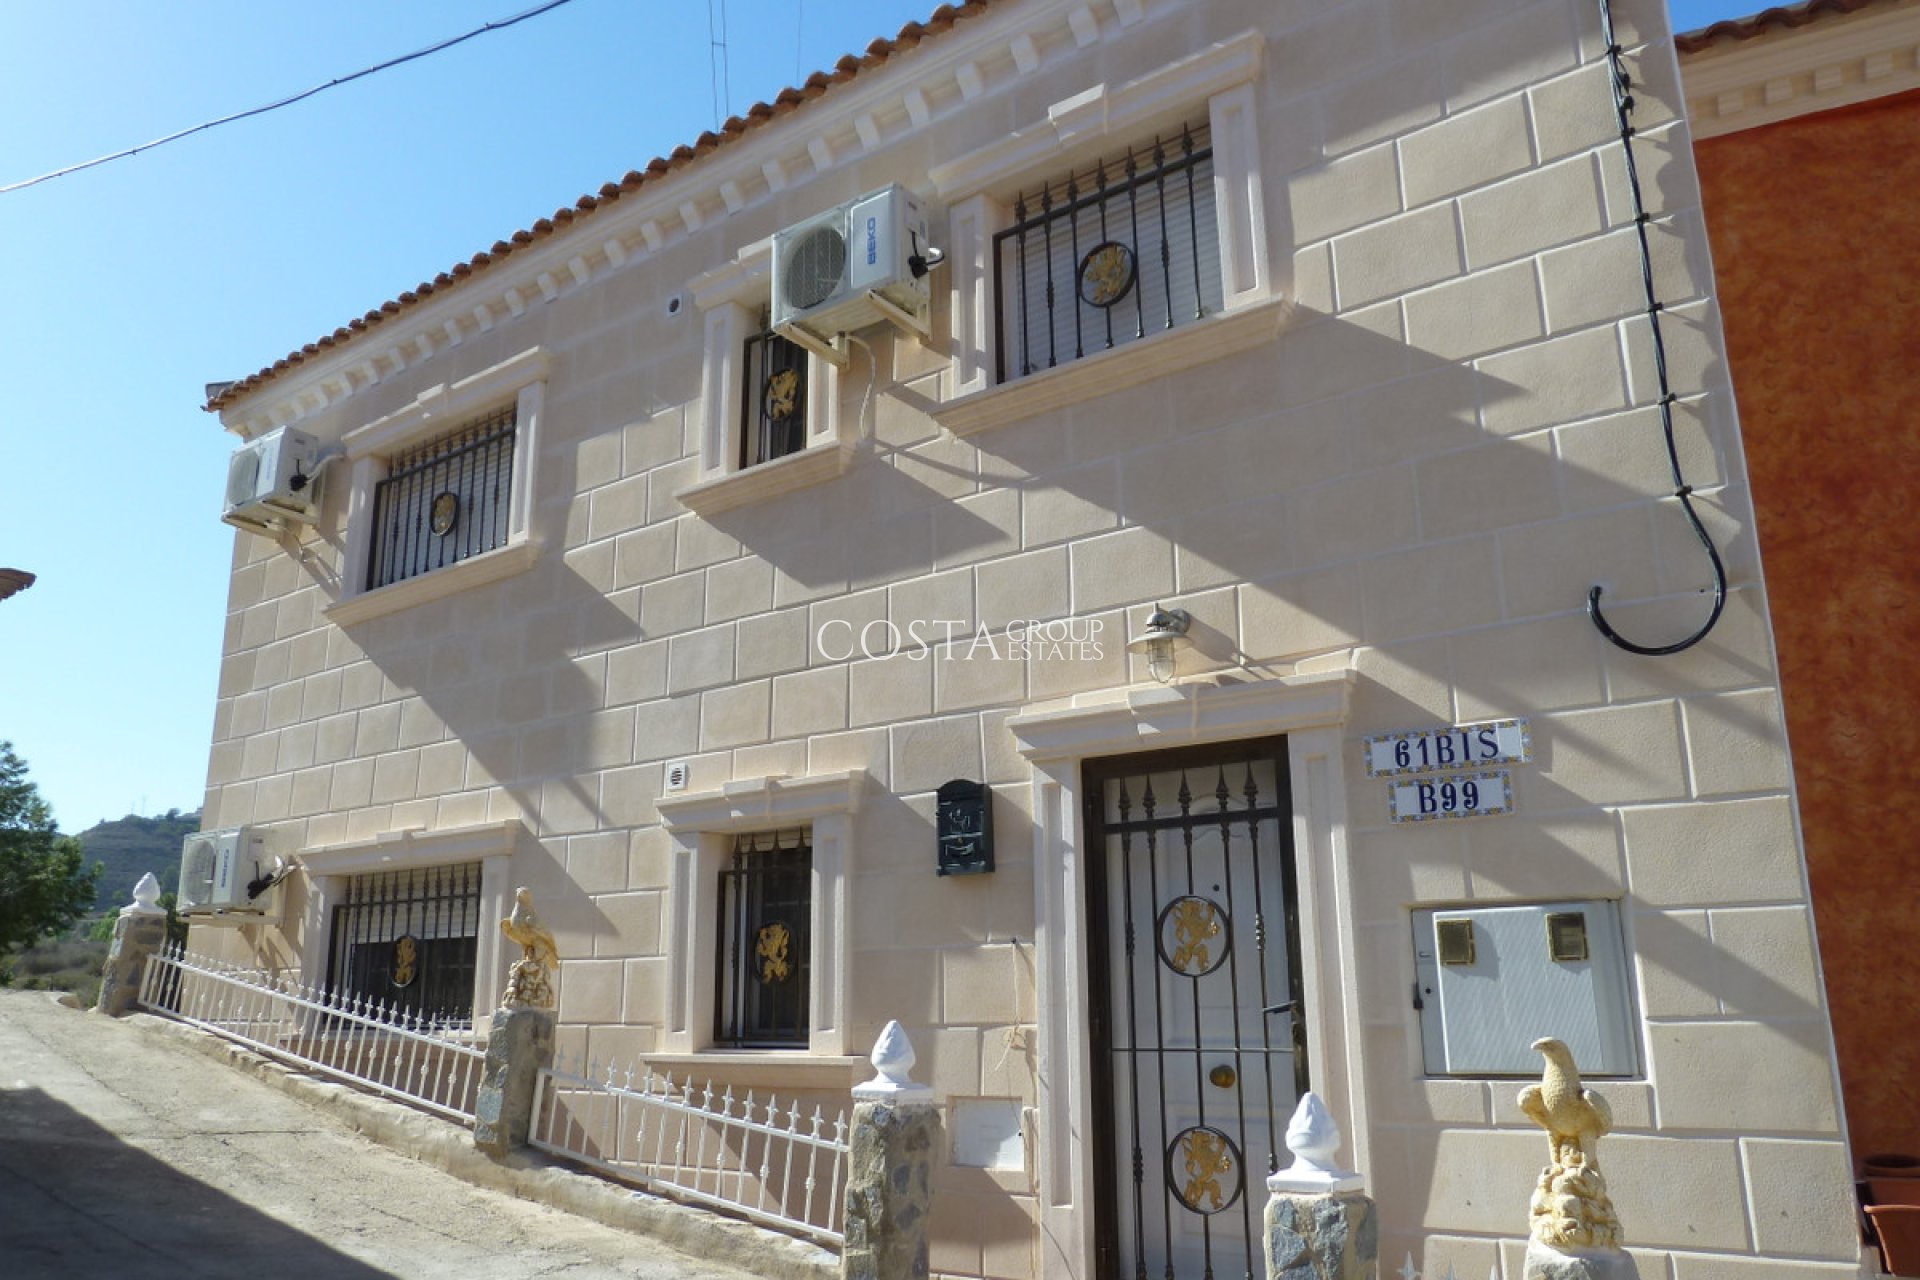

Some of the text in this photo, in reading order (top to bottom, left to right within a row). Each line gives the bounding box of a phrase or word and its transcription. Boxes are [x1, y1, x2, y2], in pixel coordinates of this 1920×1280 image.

[867, 217, 877, 265] BEKO
[1394, 729, 1499, 768] 61BIS
[1418, 780, 1479, 814] B99
